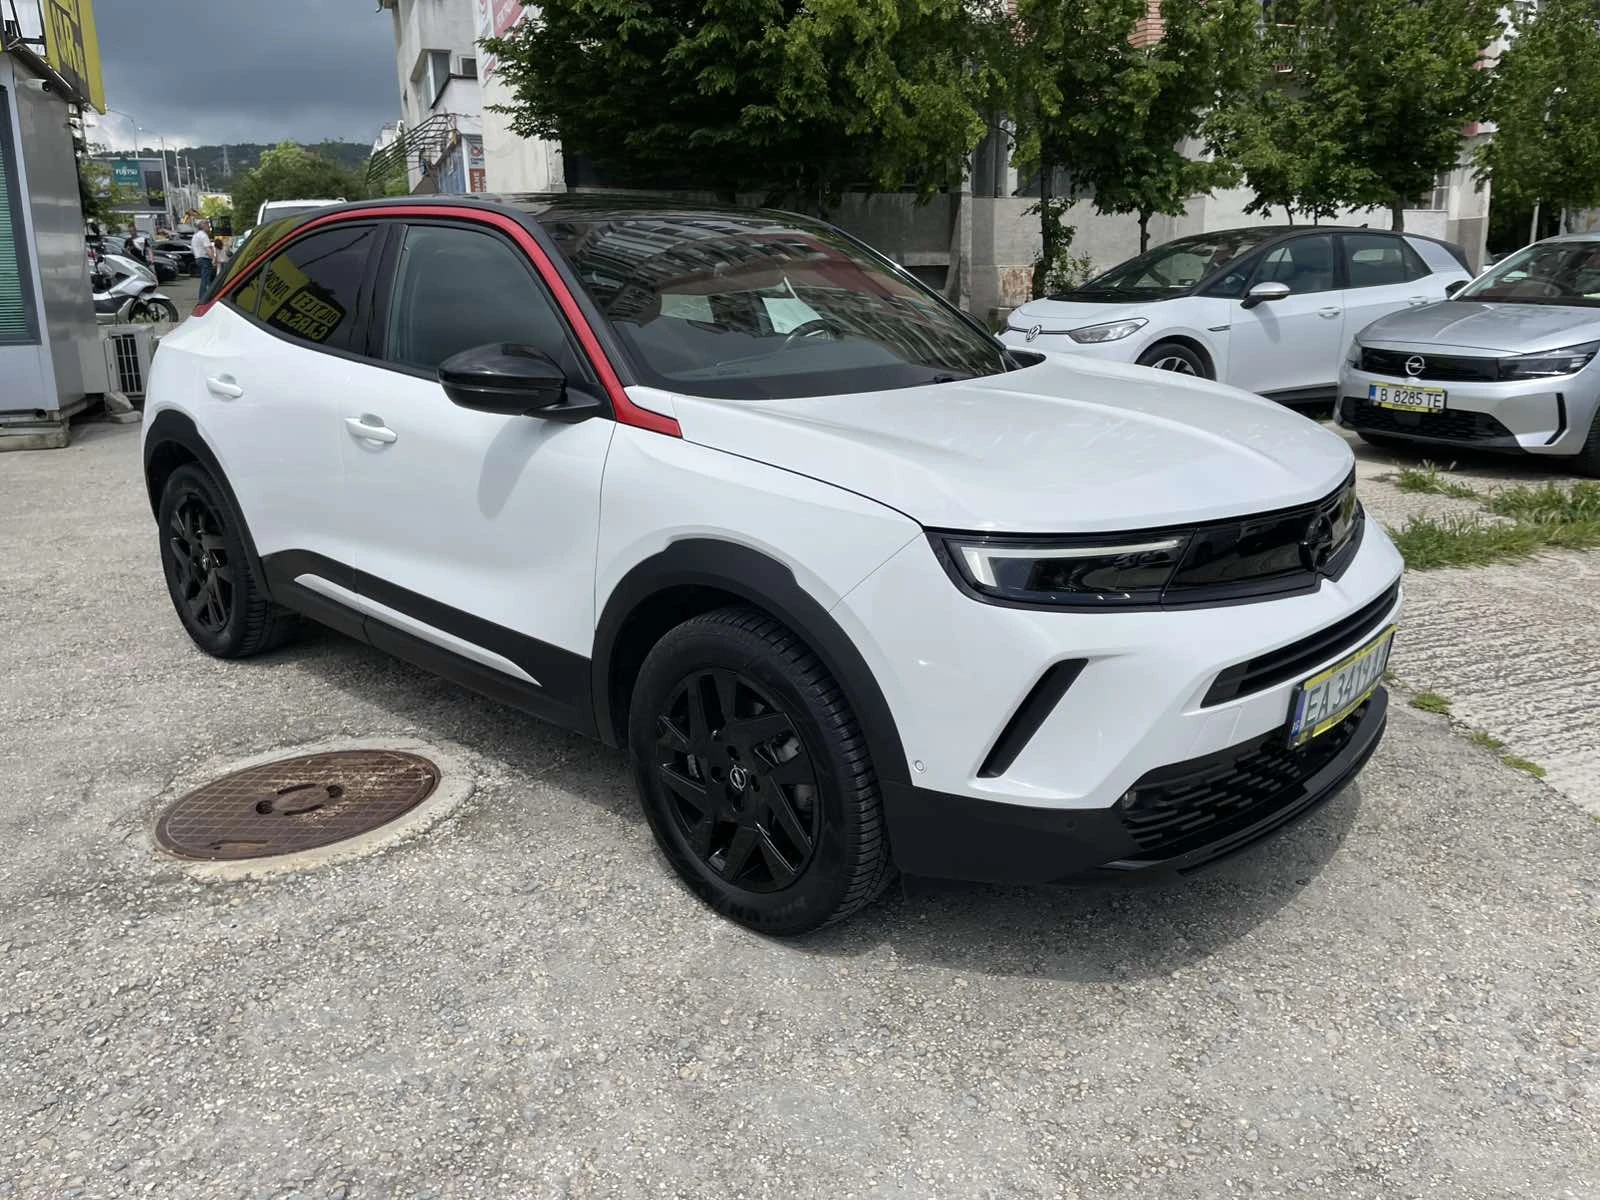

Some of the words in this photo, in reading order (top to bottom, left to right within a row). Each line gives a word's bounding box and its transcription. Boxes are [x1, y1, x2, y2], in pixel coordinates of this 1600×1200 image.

[1380, 388, 1388, 402] B
[1393, 390, 1423, 406] 8285
[1426, 392, 1442, 408] TE
[1305, 681, 1330, 725] EA
